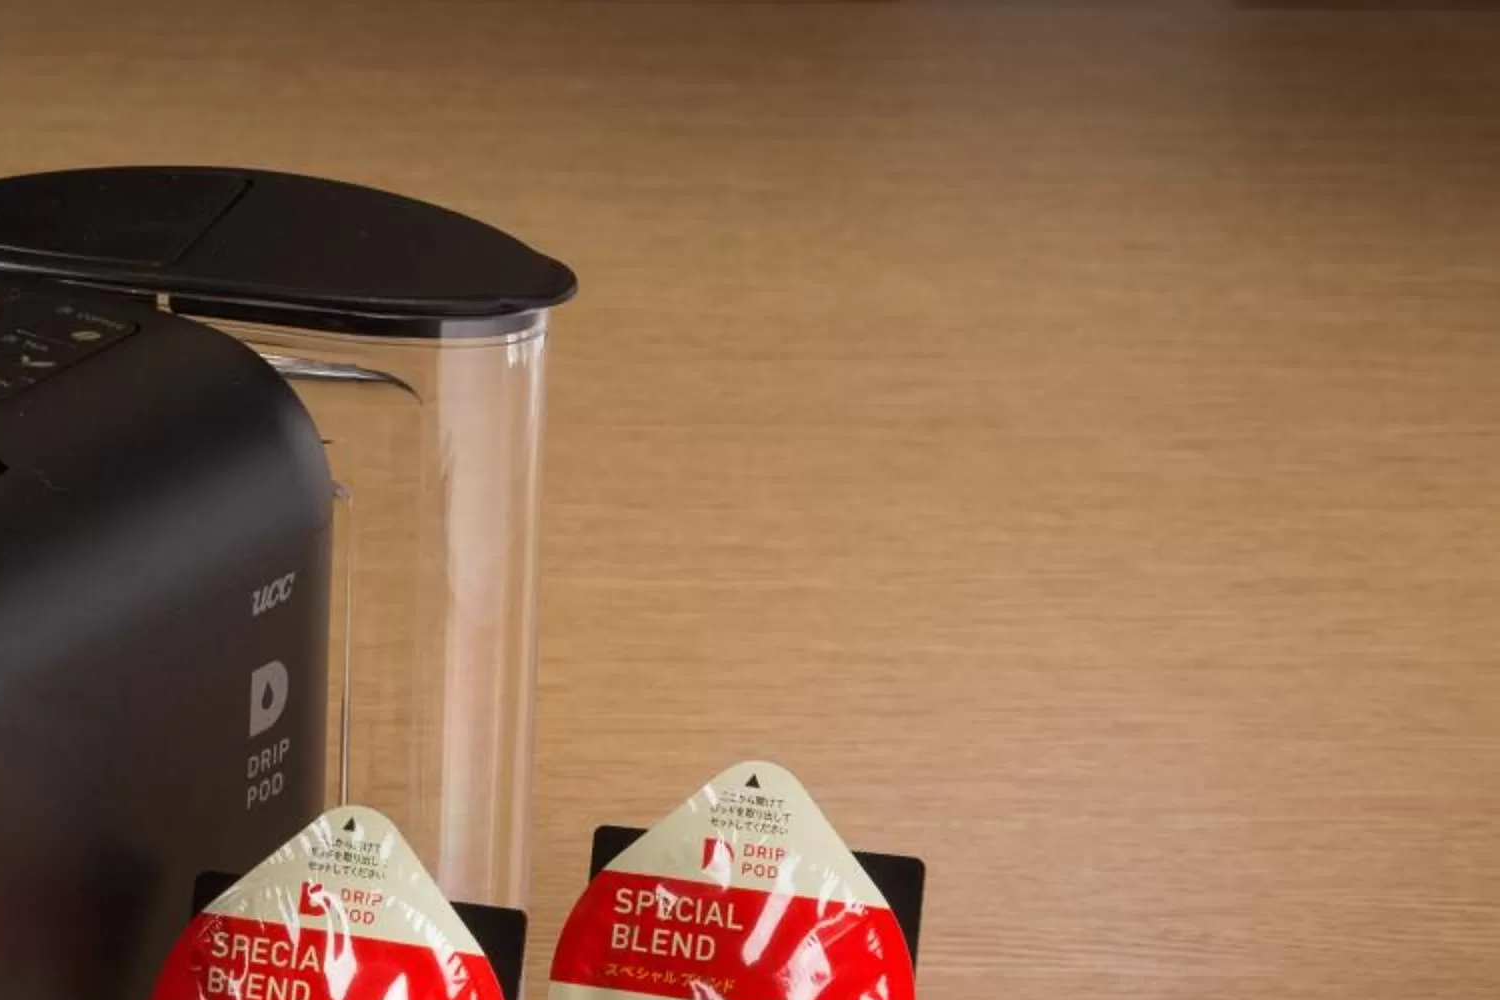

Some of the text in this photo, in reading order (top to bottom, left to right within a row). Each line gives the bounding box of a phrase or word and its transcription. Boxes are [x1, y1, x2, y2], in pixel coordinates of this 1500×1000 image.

[247, 738, 290, 778] DRIP
[247, 772, 284, 810] POD
[741, 862, 779, 879] POD
[743, 843, 786, 862] DRIP
[338, 907, 375, 925] OD
[613, 887, 745, 932] SPECIAL
[211, 931, 332, 974] SPECIA
[610, 922, 716, 961] BLEND
